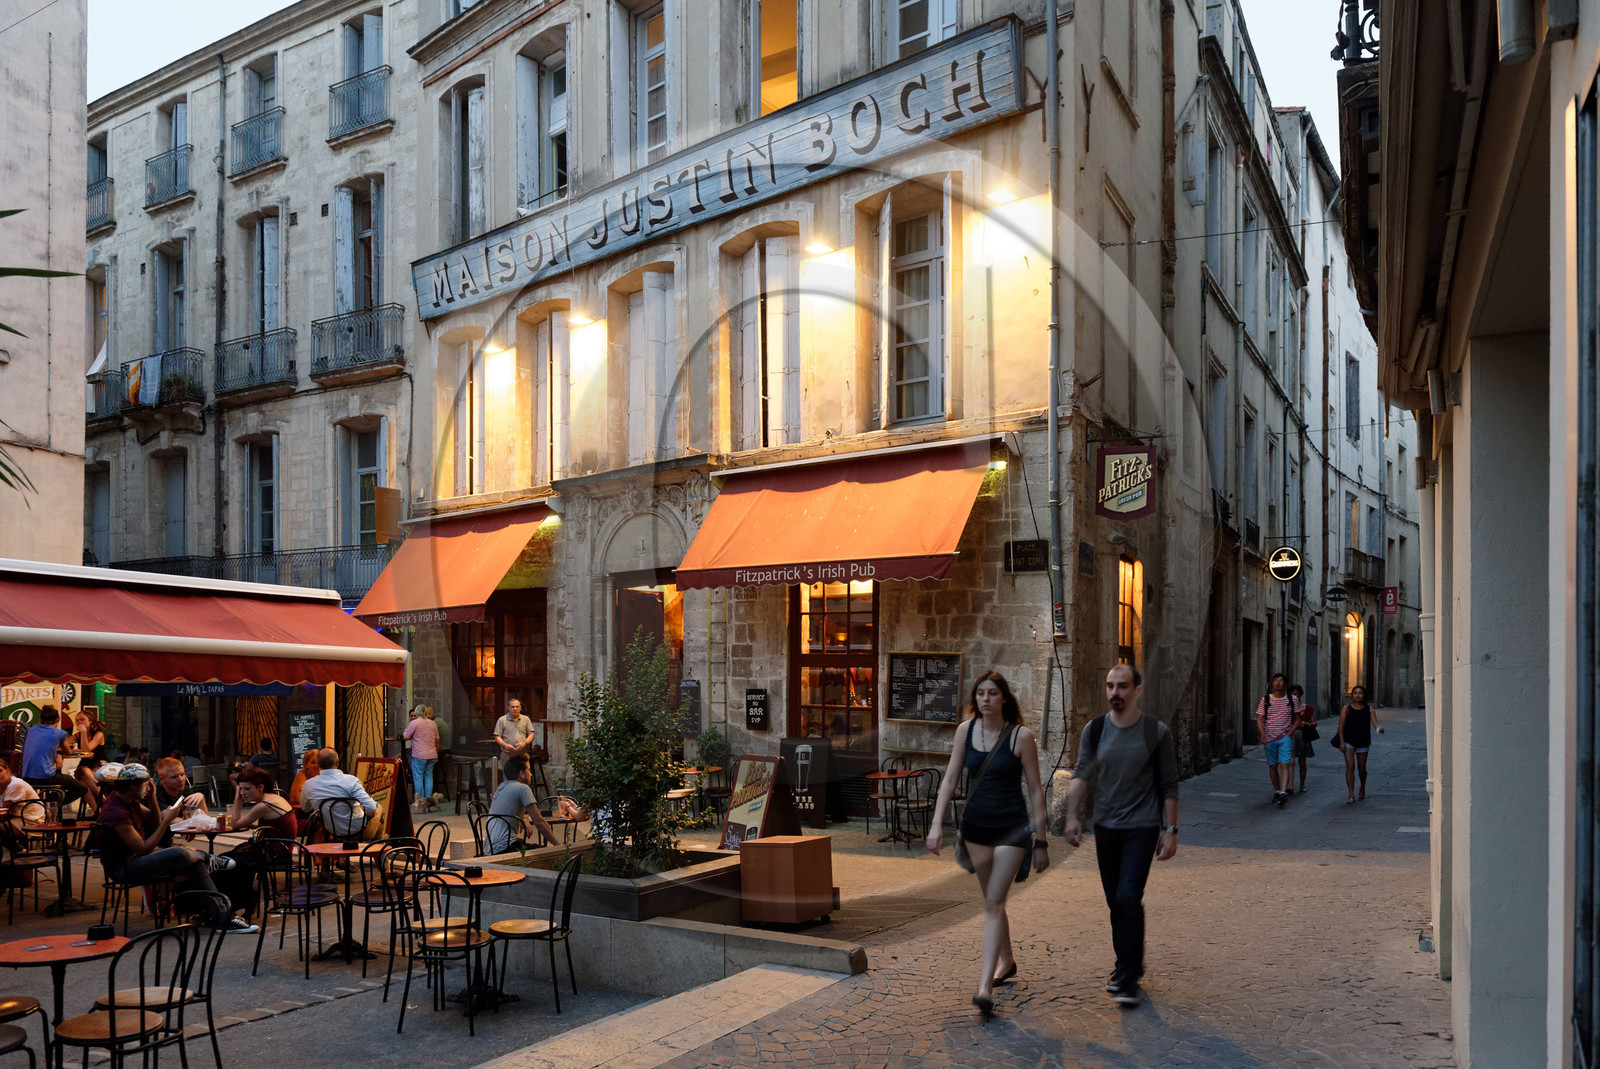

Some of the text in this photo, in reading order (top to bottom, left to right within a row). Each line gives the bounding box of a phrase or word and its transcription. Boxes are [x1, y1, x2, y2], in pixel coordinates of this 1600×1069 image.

[431, 49, 992, 308] MAISON JUSTIN BOCH
[1098, 463, 1152, 503] PATRICK'S
[1016, 544, 1036, 552] PLACE
[818, 563, 845, 579] Irish
[850, 562, 876, 577] Pub
[418, 611, 433, 622] Irish
[434, 610, 447, 621] Pub
[5, 687, 50, 703] DARTS
[749, 707, 764, 716] BAR
[793, 794, 813, 803] URE
